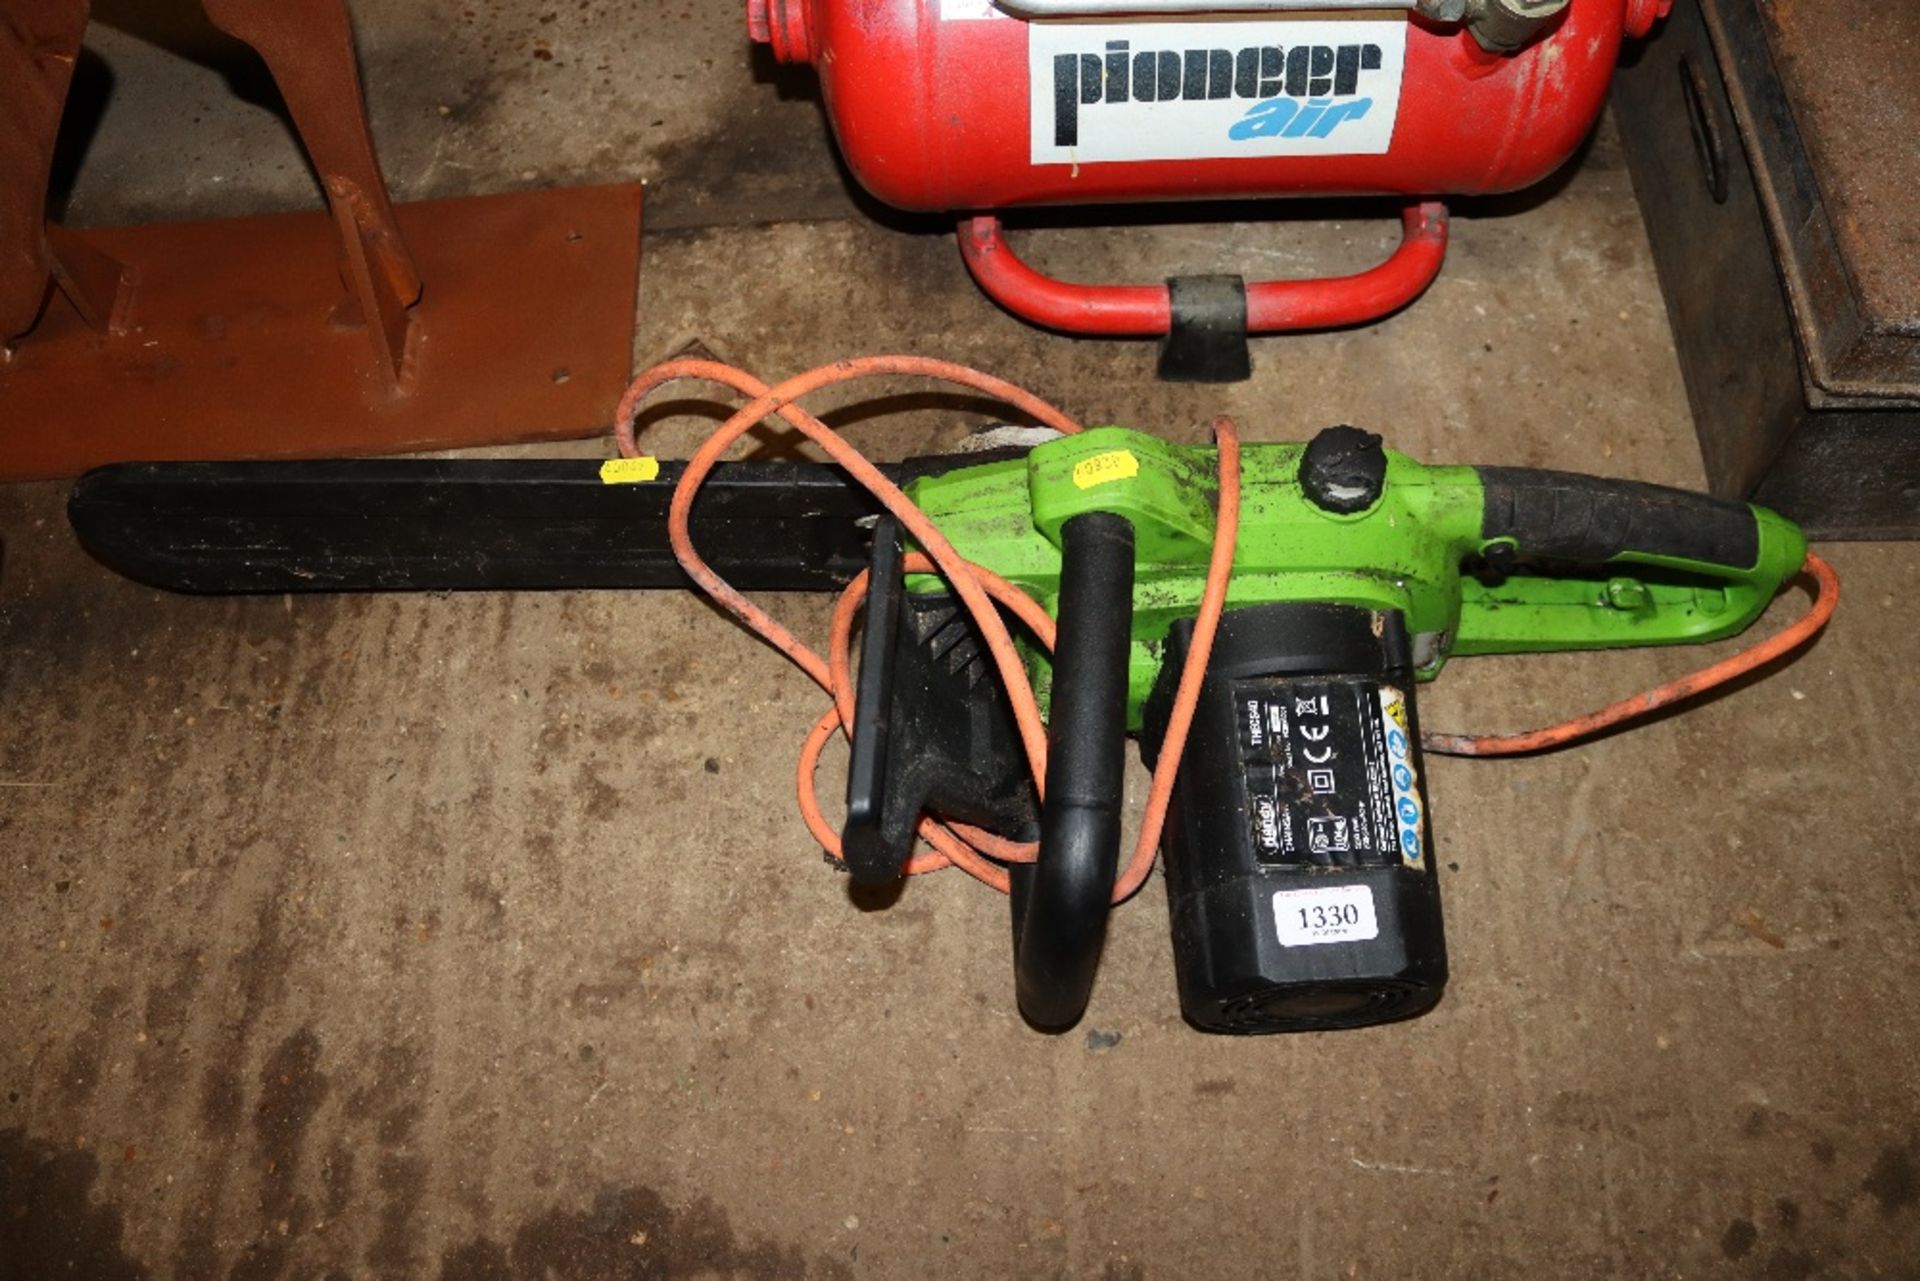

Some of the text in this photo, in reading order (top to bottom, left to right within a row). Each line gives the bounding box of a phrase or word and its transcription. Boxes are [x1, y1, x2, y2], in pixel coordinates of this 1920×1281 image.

[1053, 40, 1383, 147] pioneer
[1228, 97, 1373, 141] air
[1297, 903, 1359, 929] 1330
